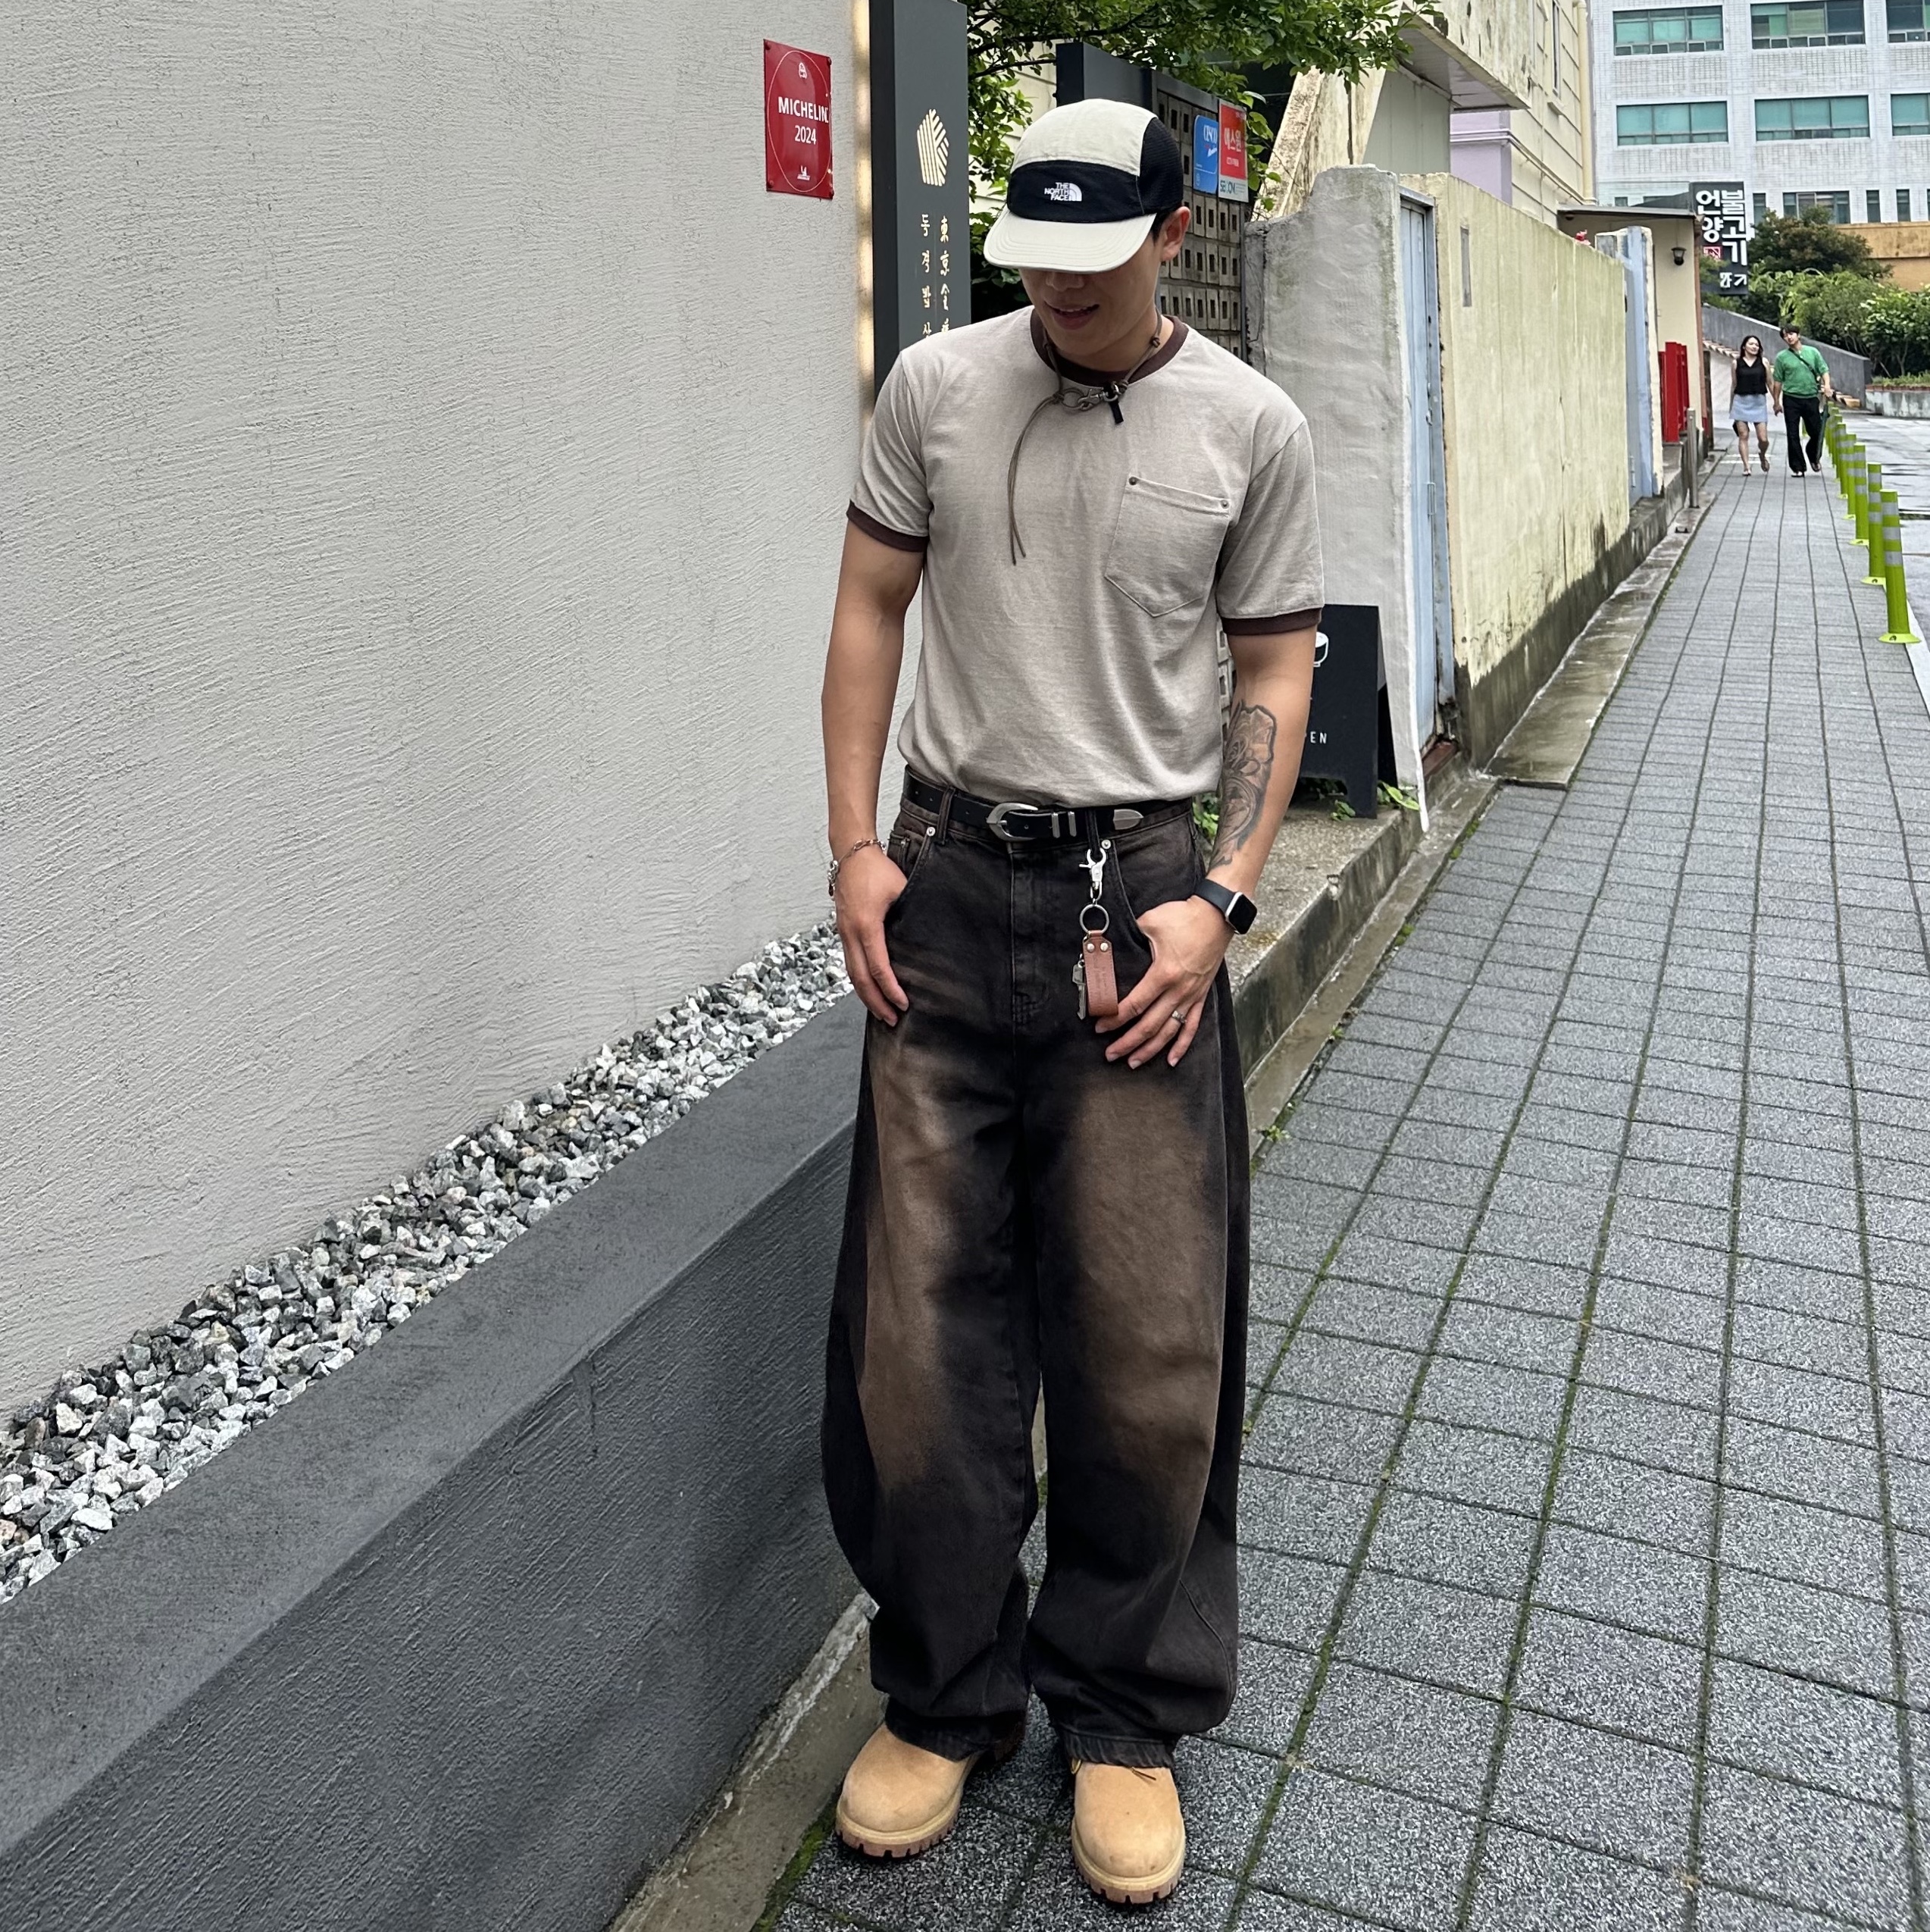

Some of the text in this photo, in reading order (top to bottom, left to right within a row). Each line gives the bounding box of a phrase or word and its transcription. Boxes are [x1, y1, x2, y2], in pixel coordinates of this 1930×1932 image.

[777, 96, 828, 124] MICHELIN
[794, 124, 817, 145] 2024
[1224, 127, 1242, 152] 에스원
[1044, 187, 1070, 196] NORTH
[1696, 189, 1724, 243] 언양
[1721, 189, 1747, 265] 불고기
